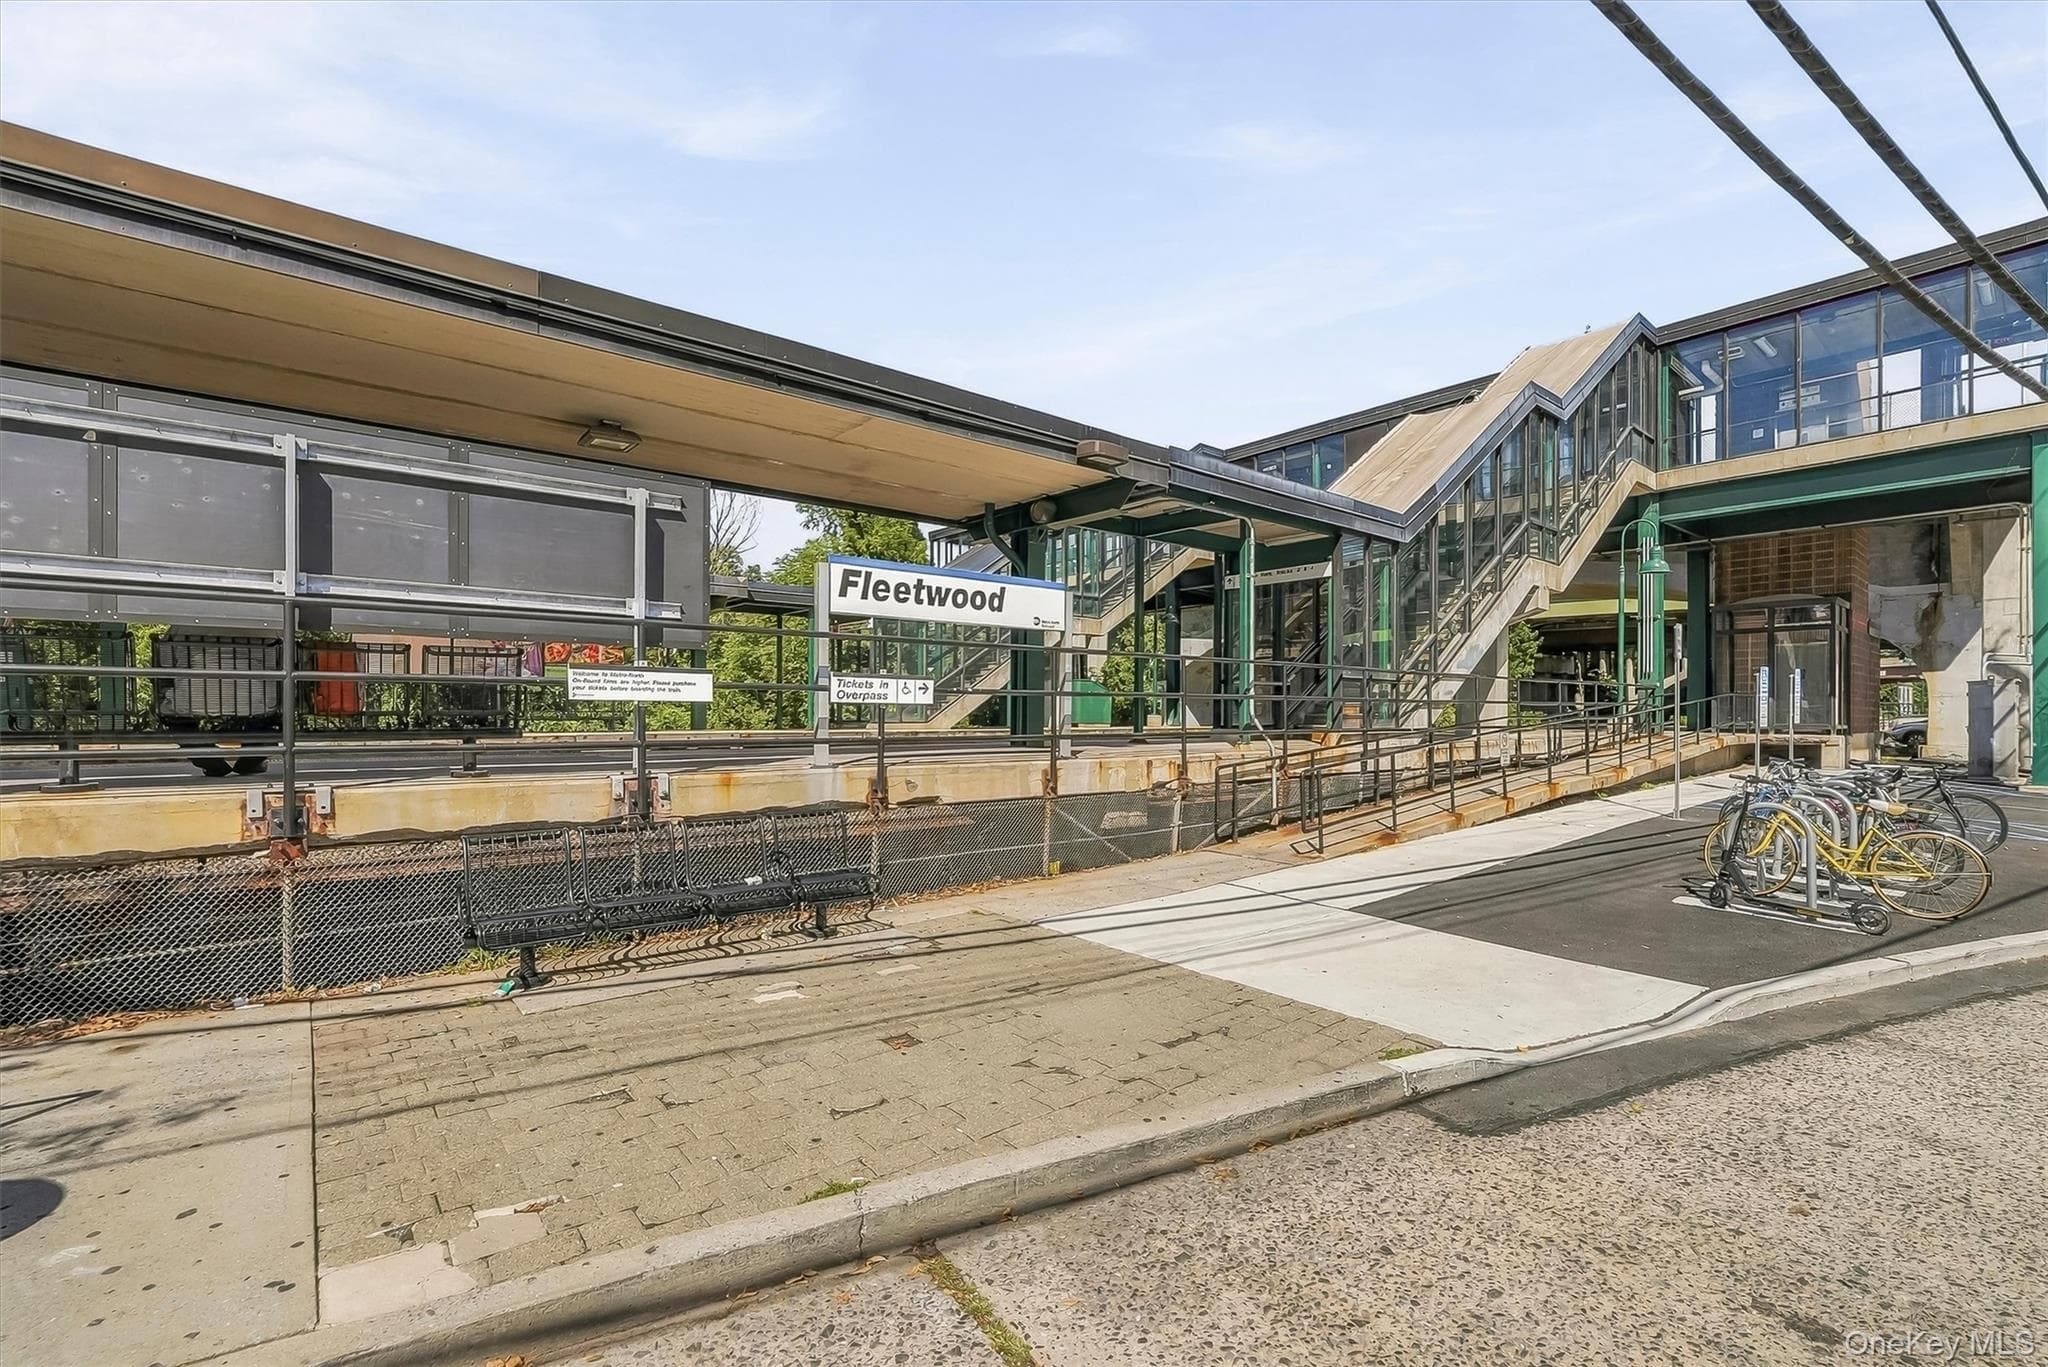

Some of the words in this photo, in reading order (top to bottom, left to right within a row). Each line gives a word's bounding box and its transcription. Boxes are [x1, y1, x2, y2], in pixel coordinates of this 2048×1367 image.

[838, 568, 1006, 613] Fleetwood
[837, 679, 874, 690] Tickets
[879, 680, 889, 690] in
[836, 689, 889, 701] Overpass
